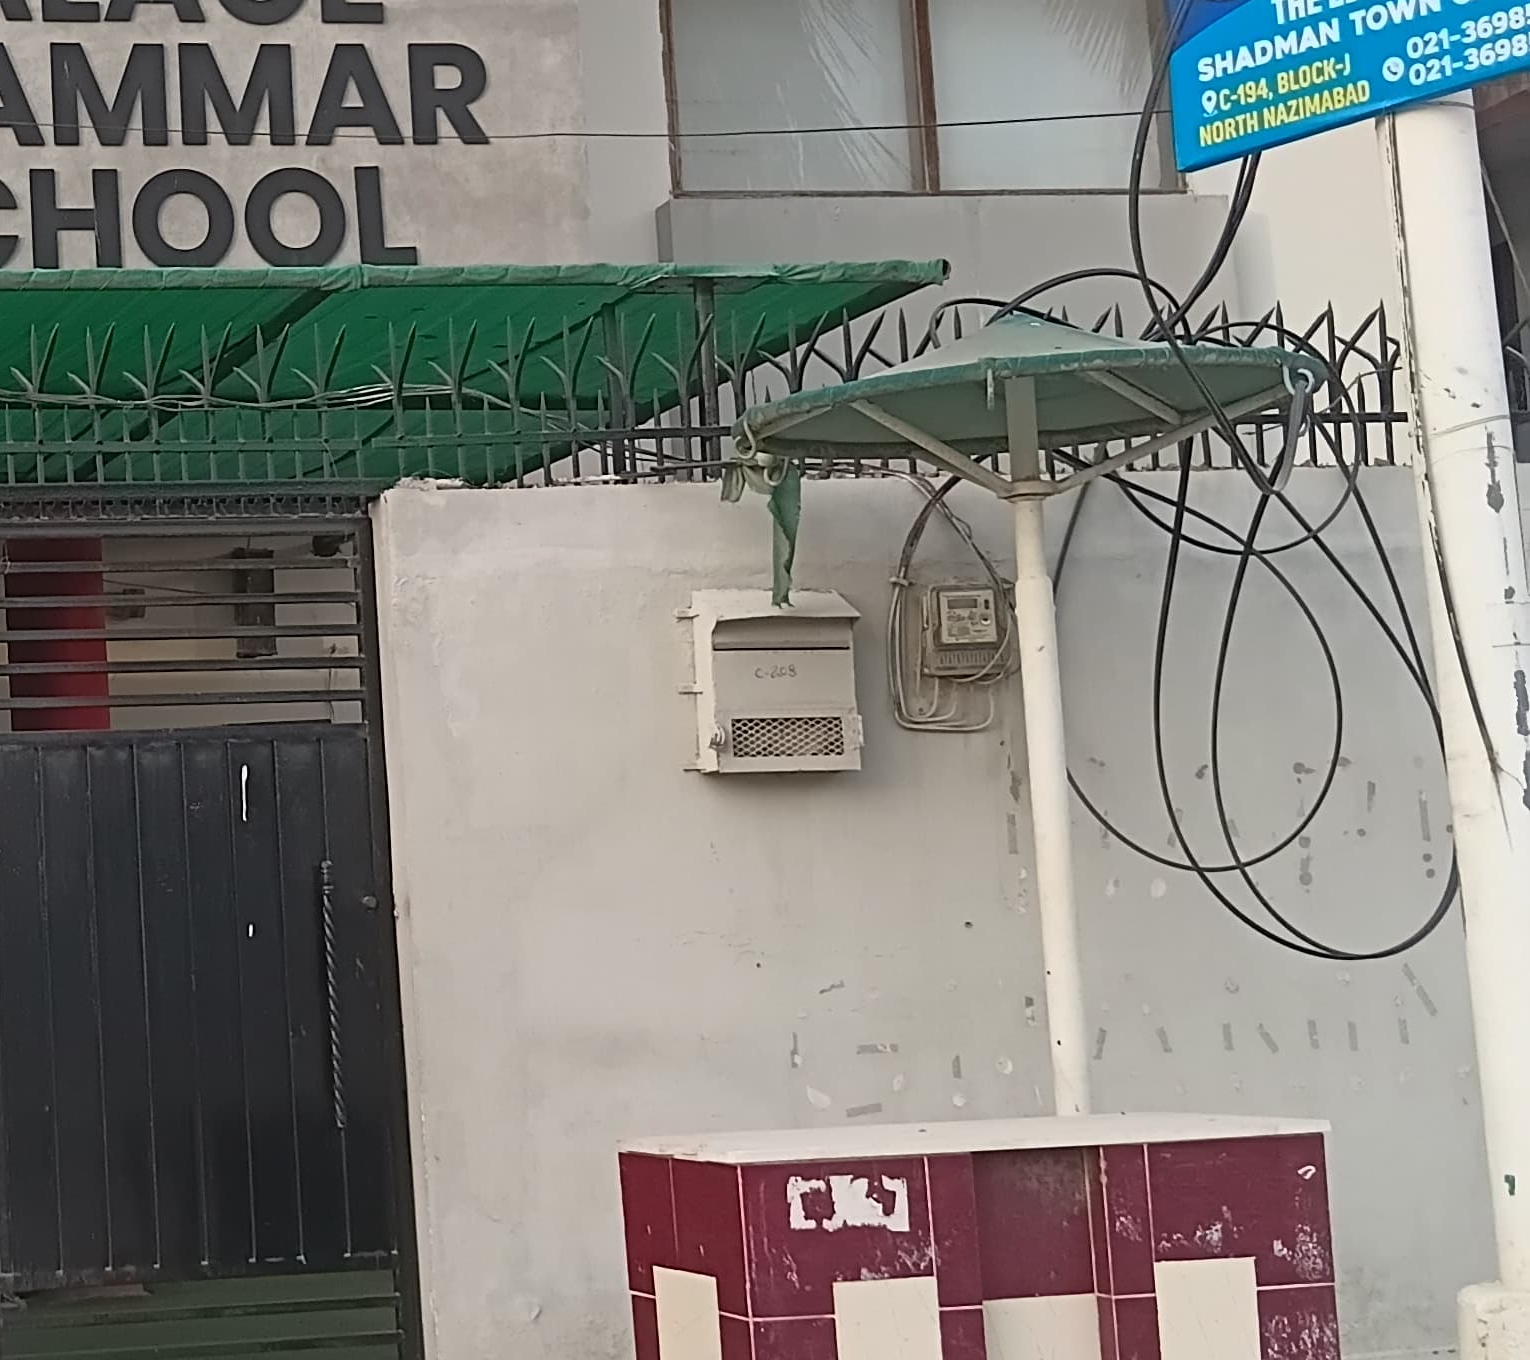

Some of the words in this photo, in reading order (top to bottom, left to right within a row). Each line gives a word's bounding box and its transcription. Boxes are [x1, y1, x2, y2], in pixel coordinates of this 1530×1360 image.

[1197, 17, 1340, 82] SHADMAN
[1406, 4, 1530, 59] 021-3698
[1409, 32, 1530, 86] 021-3698
[1277, 53, 1351, 95] BLOCK-J
[1199, 111, 1259, 147] NORTH
[1263, 80, 1370, 129] NAZIMABAD
